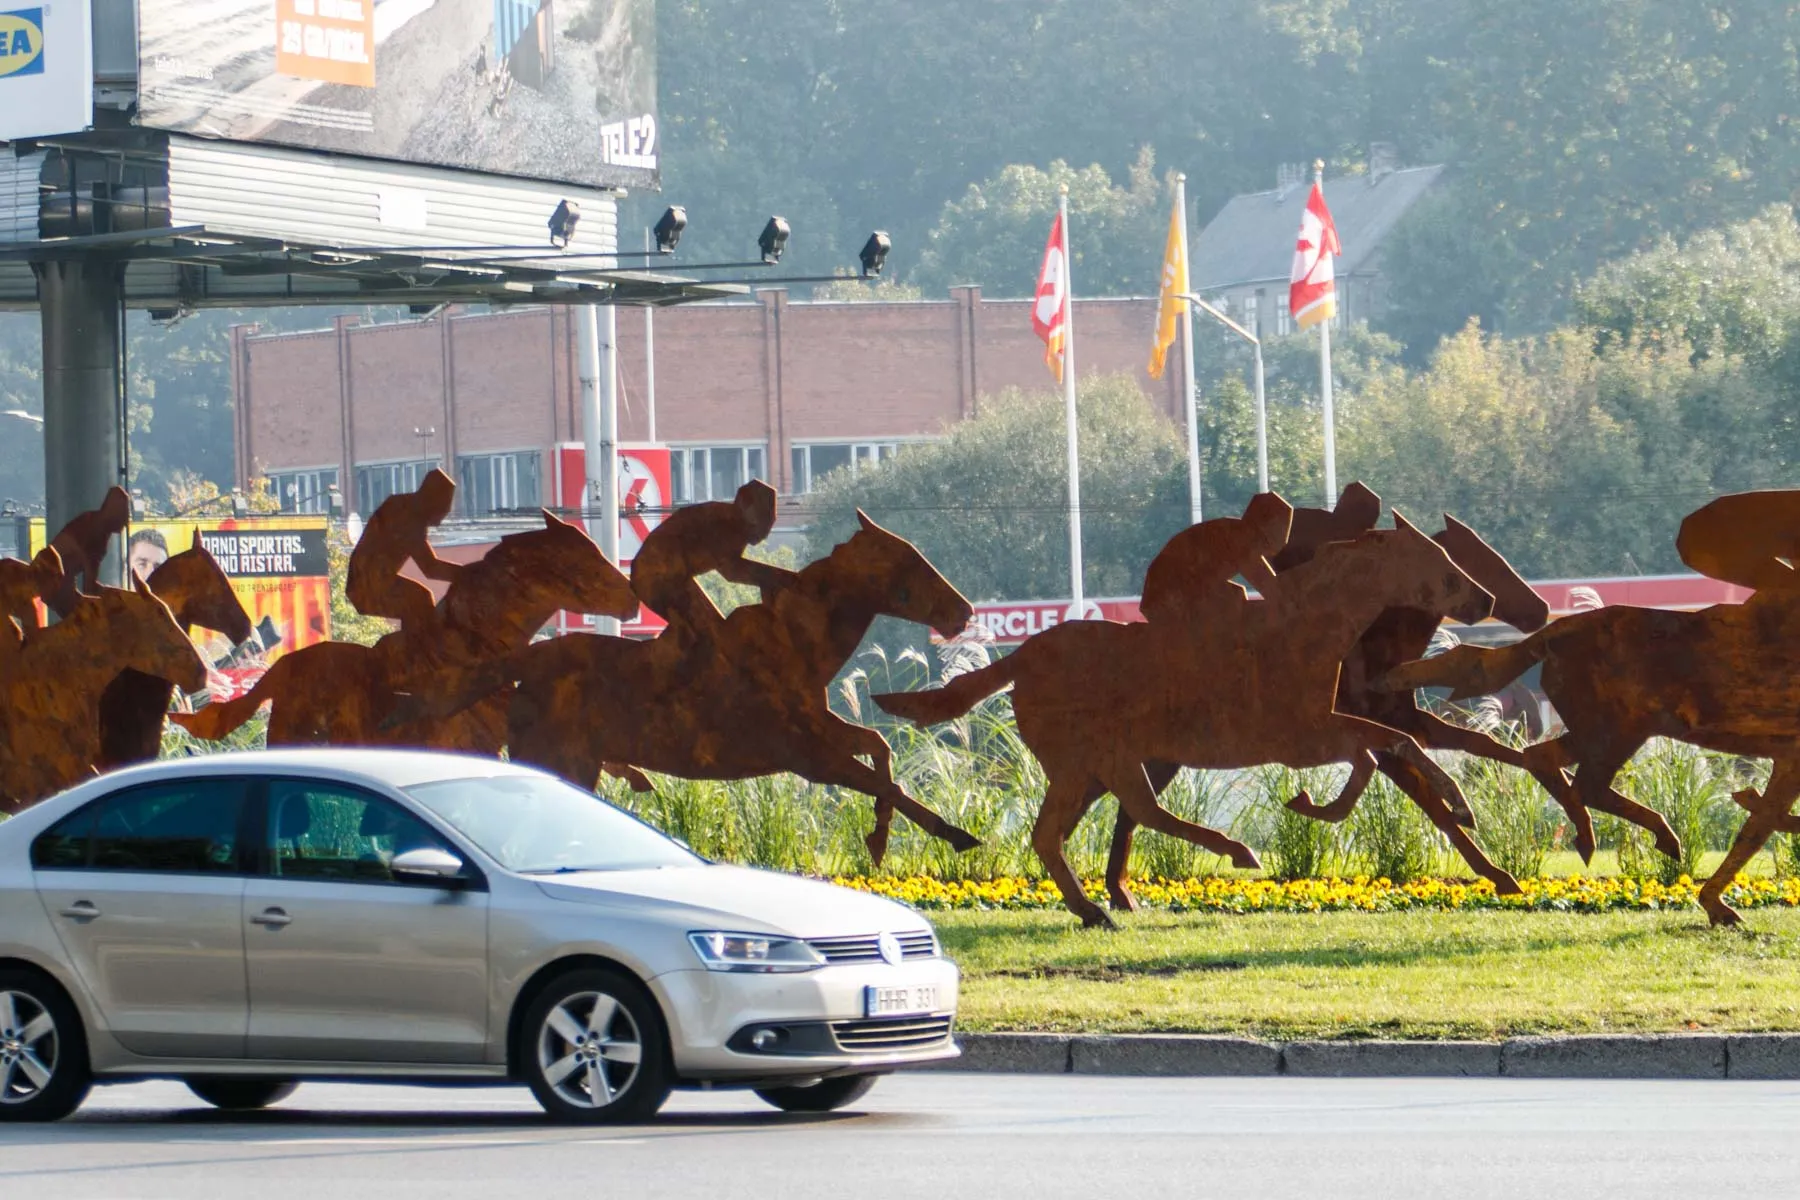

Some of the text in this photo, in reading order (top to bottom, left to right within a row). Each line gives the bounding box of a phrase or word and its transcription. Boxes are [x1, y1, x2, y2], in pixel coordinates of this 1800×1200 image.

[600, 113, 656, 169] TELE2
[239, 535, 306, 554] SPORTAS.
[241, 554, 297, 573] AISTRA.
[974, 609, 1058, 637] IRCLE
